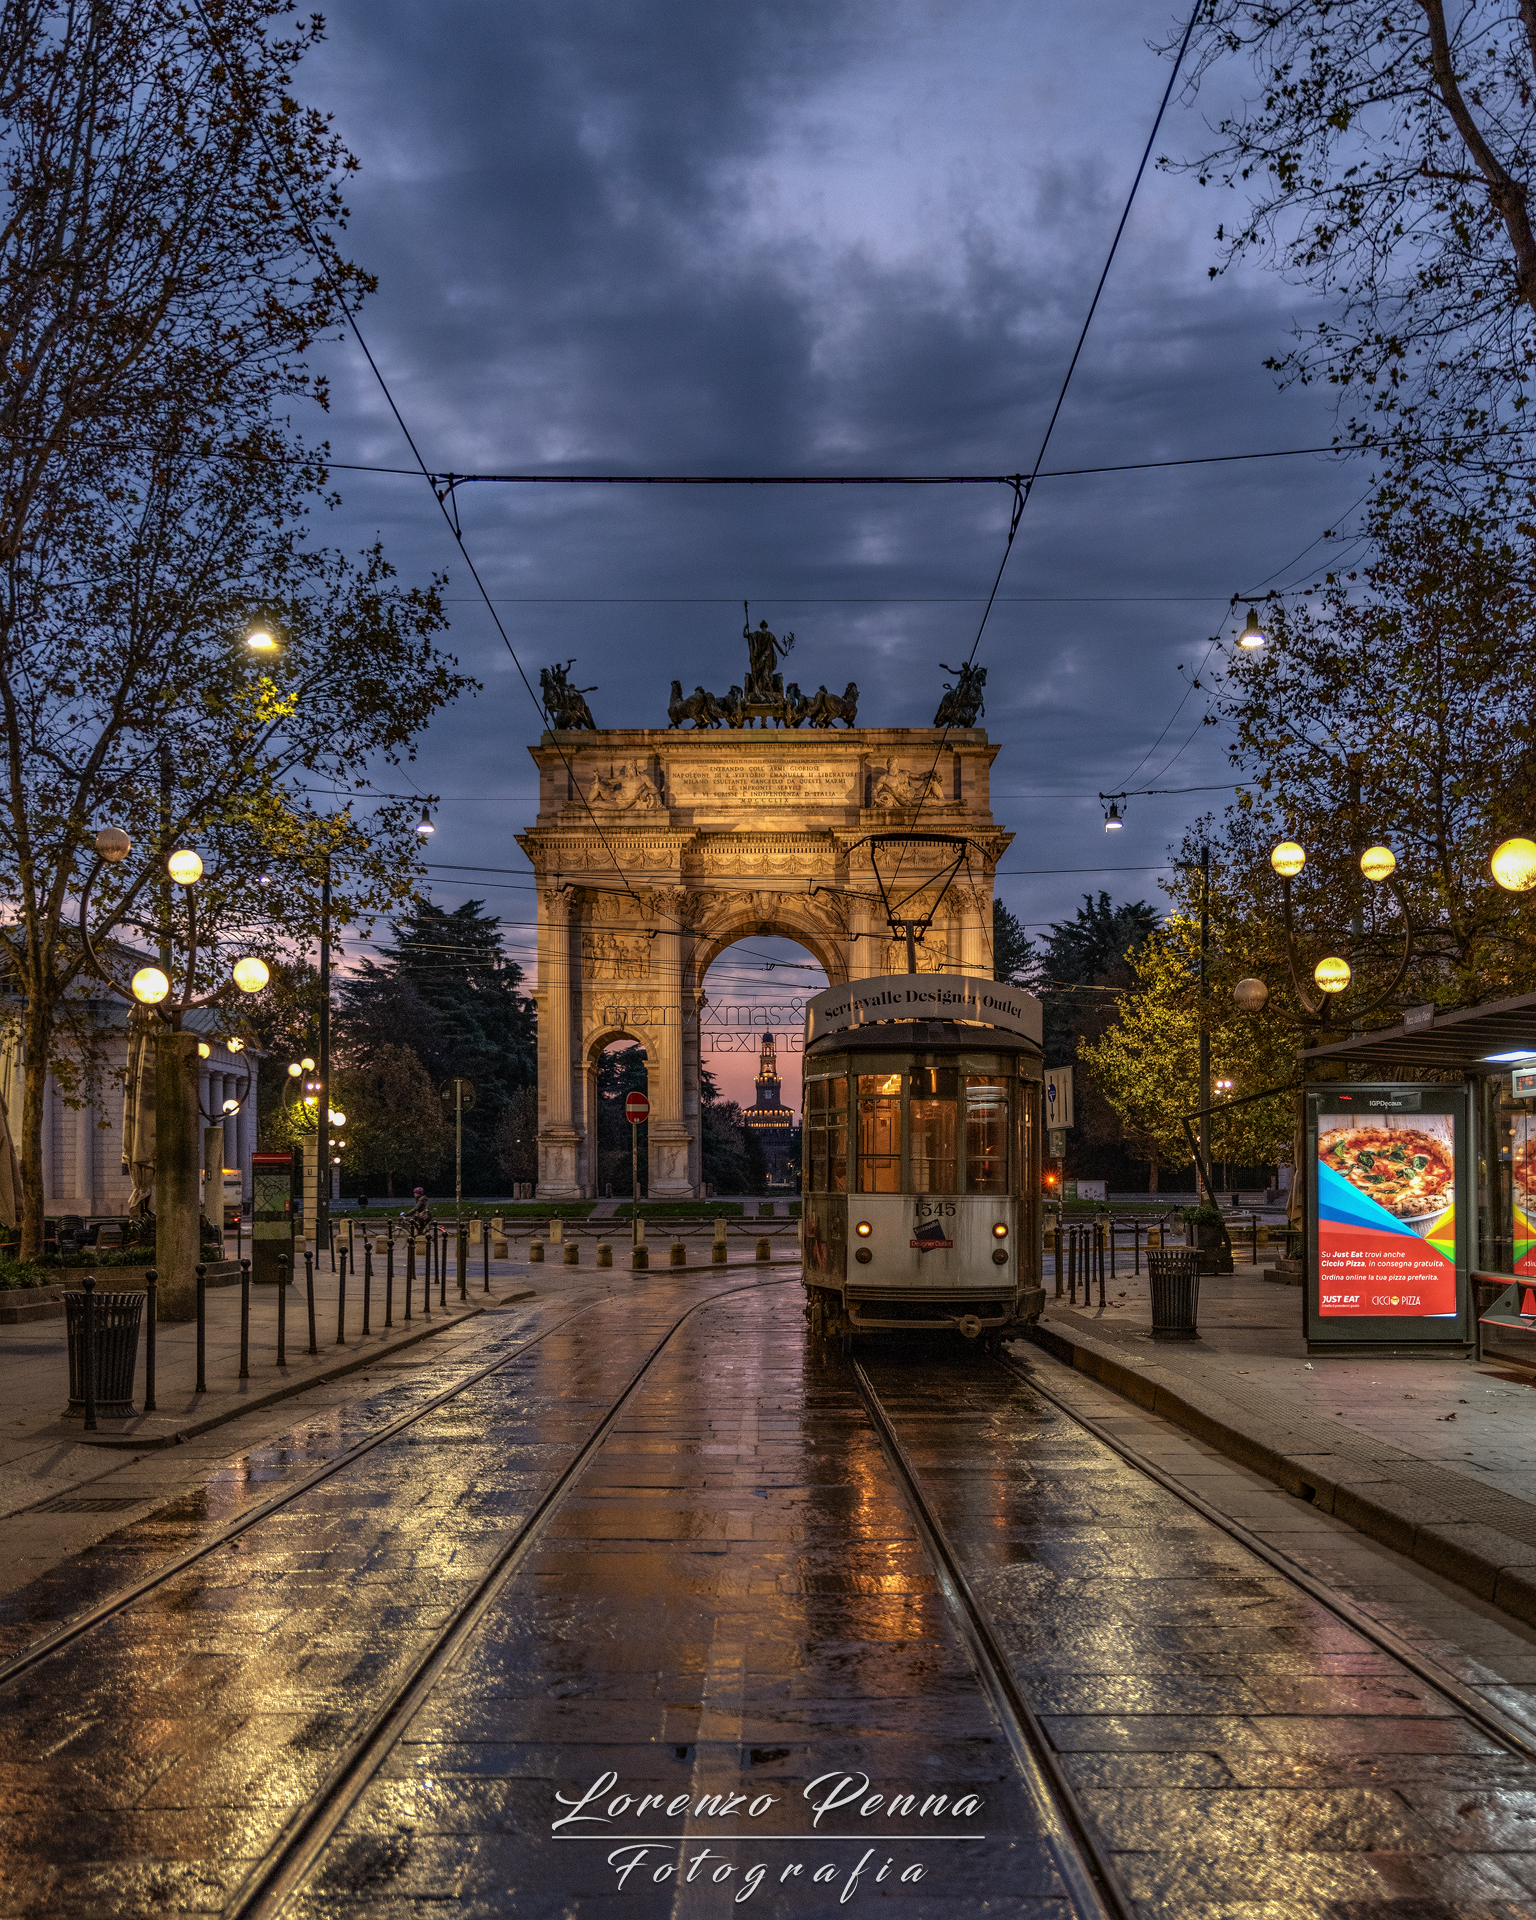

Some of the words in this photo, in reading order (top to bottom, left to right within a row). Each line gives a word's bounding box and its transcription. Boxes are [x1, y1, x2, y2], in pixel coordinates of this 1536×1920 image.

[825, 990, 902, 1021] Serravalle
[905, 988, 977, 1005] Designer
[983, 994, 1022, 1019] Outlet
[914, 1202, 956, 1217] 1545
[1345, 1260, 1367, 1268] Pizza,
[1377, 1261, 1412, 1269] consegna
[1413, 1260, 1445, 1269] gratuita.
[1388, 1273, 1406, 1282] pizza
[1407, 1273, 1439, 1282] preferita.
[1322, 1295, 1343, 1304] JUST
[1343, 1295, 1360, 1303] EAT
[1401, 1296, 1421, 1306] PIZZA
